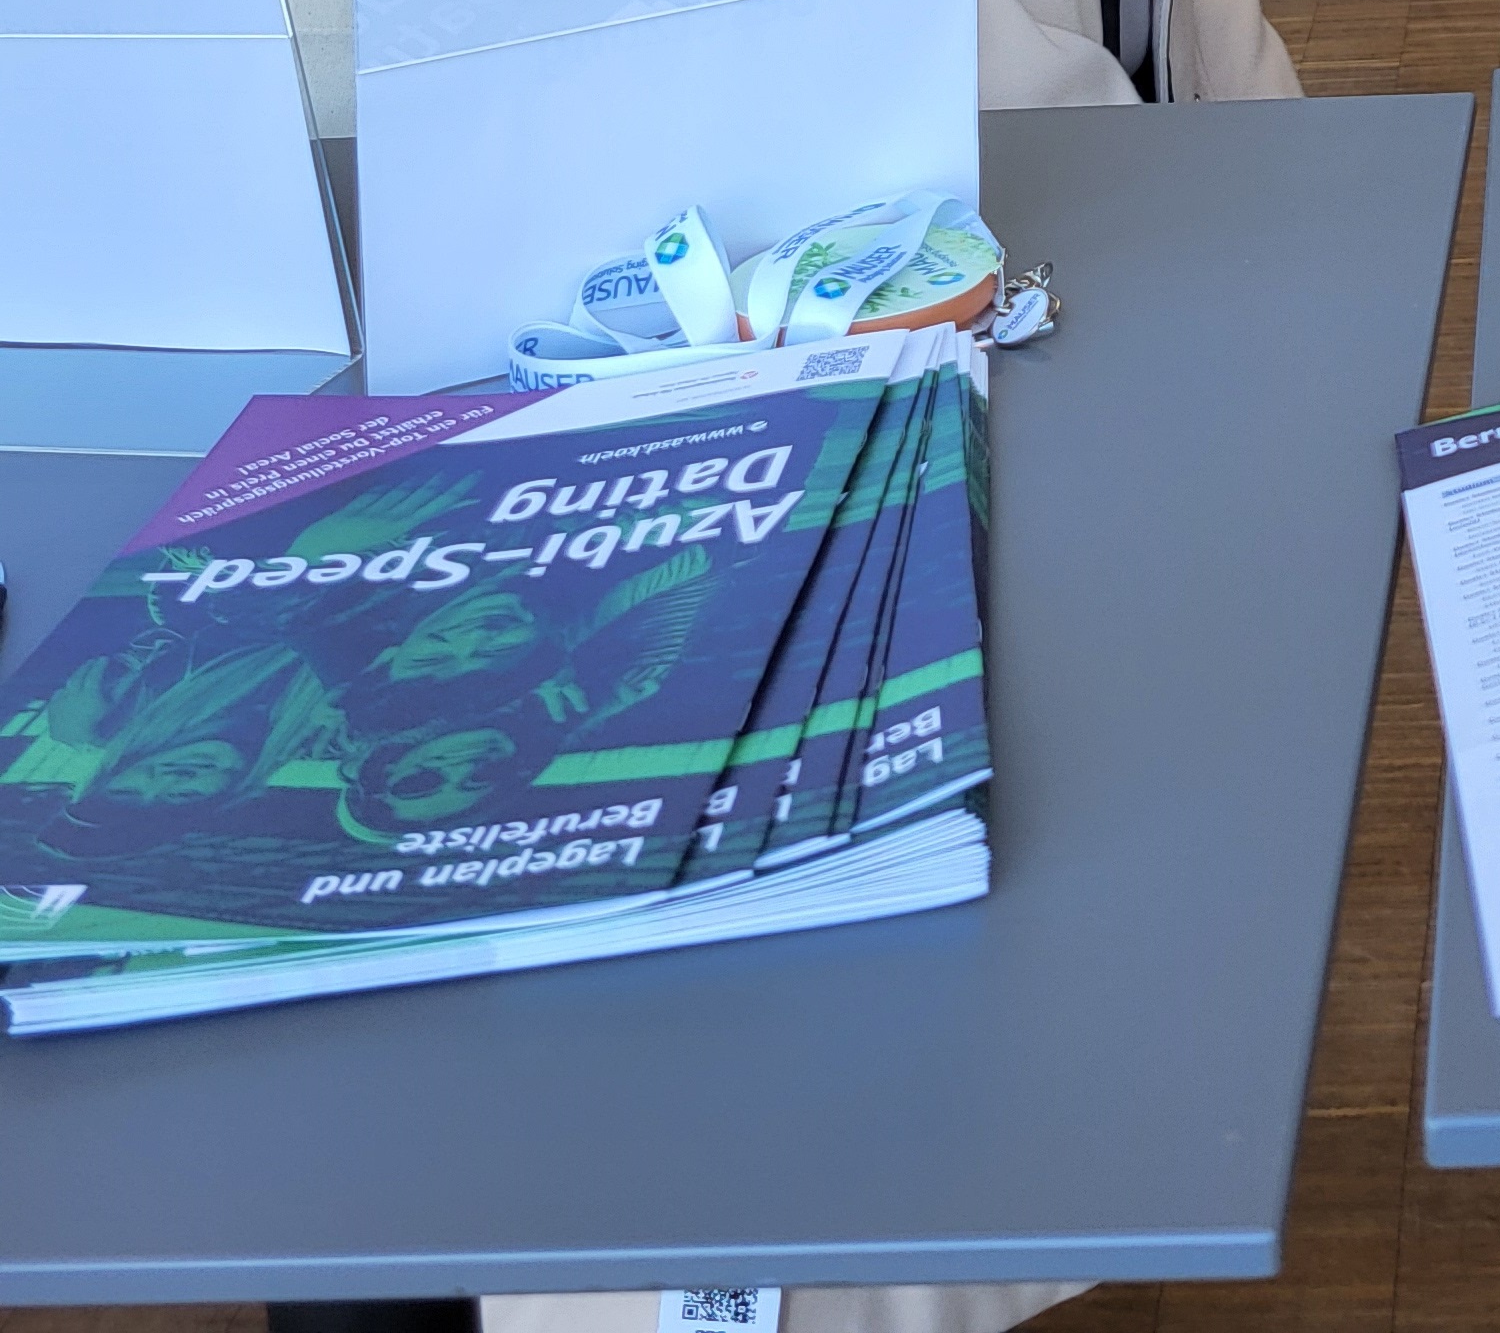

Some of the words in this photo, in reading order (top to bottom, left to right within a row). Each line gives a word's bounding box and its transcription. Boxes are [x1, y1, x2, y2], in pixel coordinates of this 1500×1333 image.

[831, 243, 902, 280] MAUSER
[582, 272, 660, 306] AUSE
[356, 415, 390, 433] der
[370, 409, 445, 442] erhältst
[425, 418, 458, 434] ein
[459, 404, 495, 424] Für
[296, 428, 358, 456] Social
[338, 435, 372, 452] Du
[578, 423, 745, 465] www.asd.koeln
[238, 450, 293, 476] Area!
[283, 448, 338, 474] einen
[177, 431, 429, 525] Top-Vorstellungsgespräch
[205, 486, 230, 501] in
[228, 468, 285, 491] Preis
[486, 445, 795, 524] Dating
[141, 489, 806, 603] Azubi-Speed-
[395, 795, 665, 855] Berufeliste
[421, 834, 647, 889] Lageplan
[301, 866, 405, 904] und
